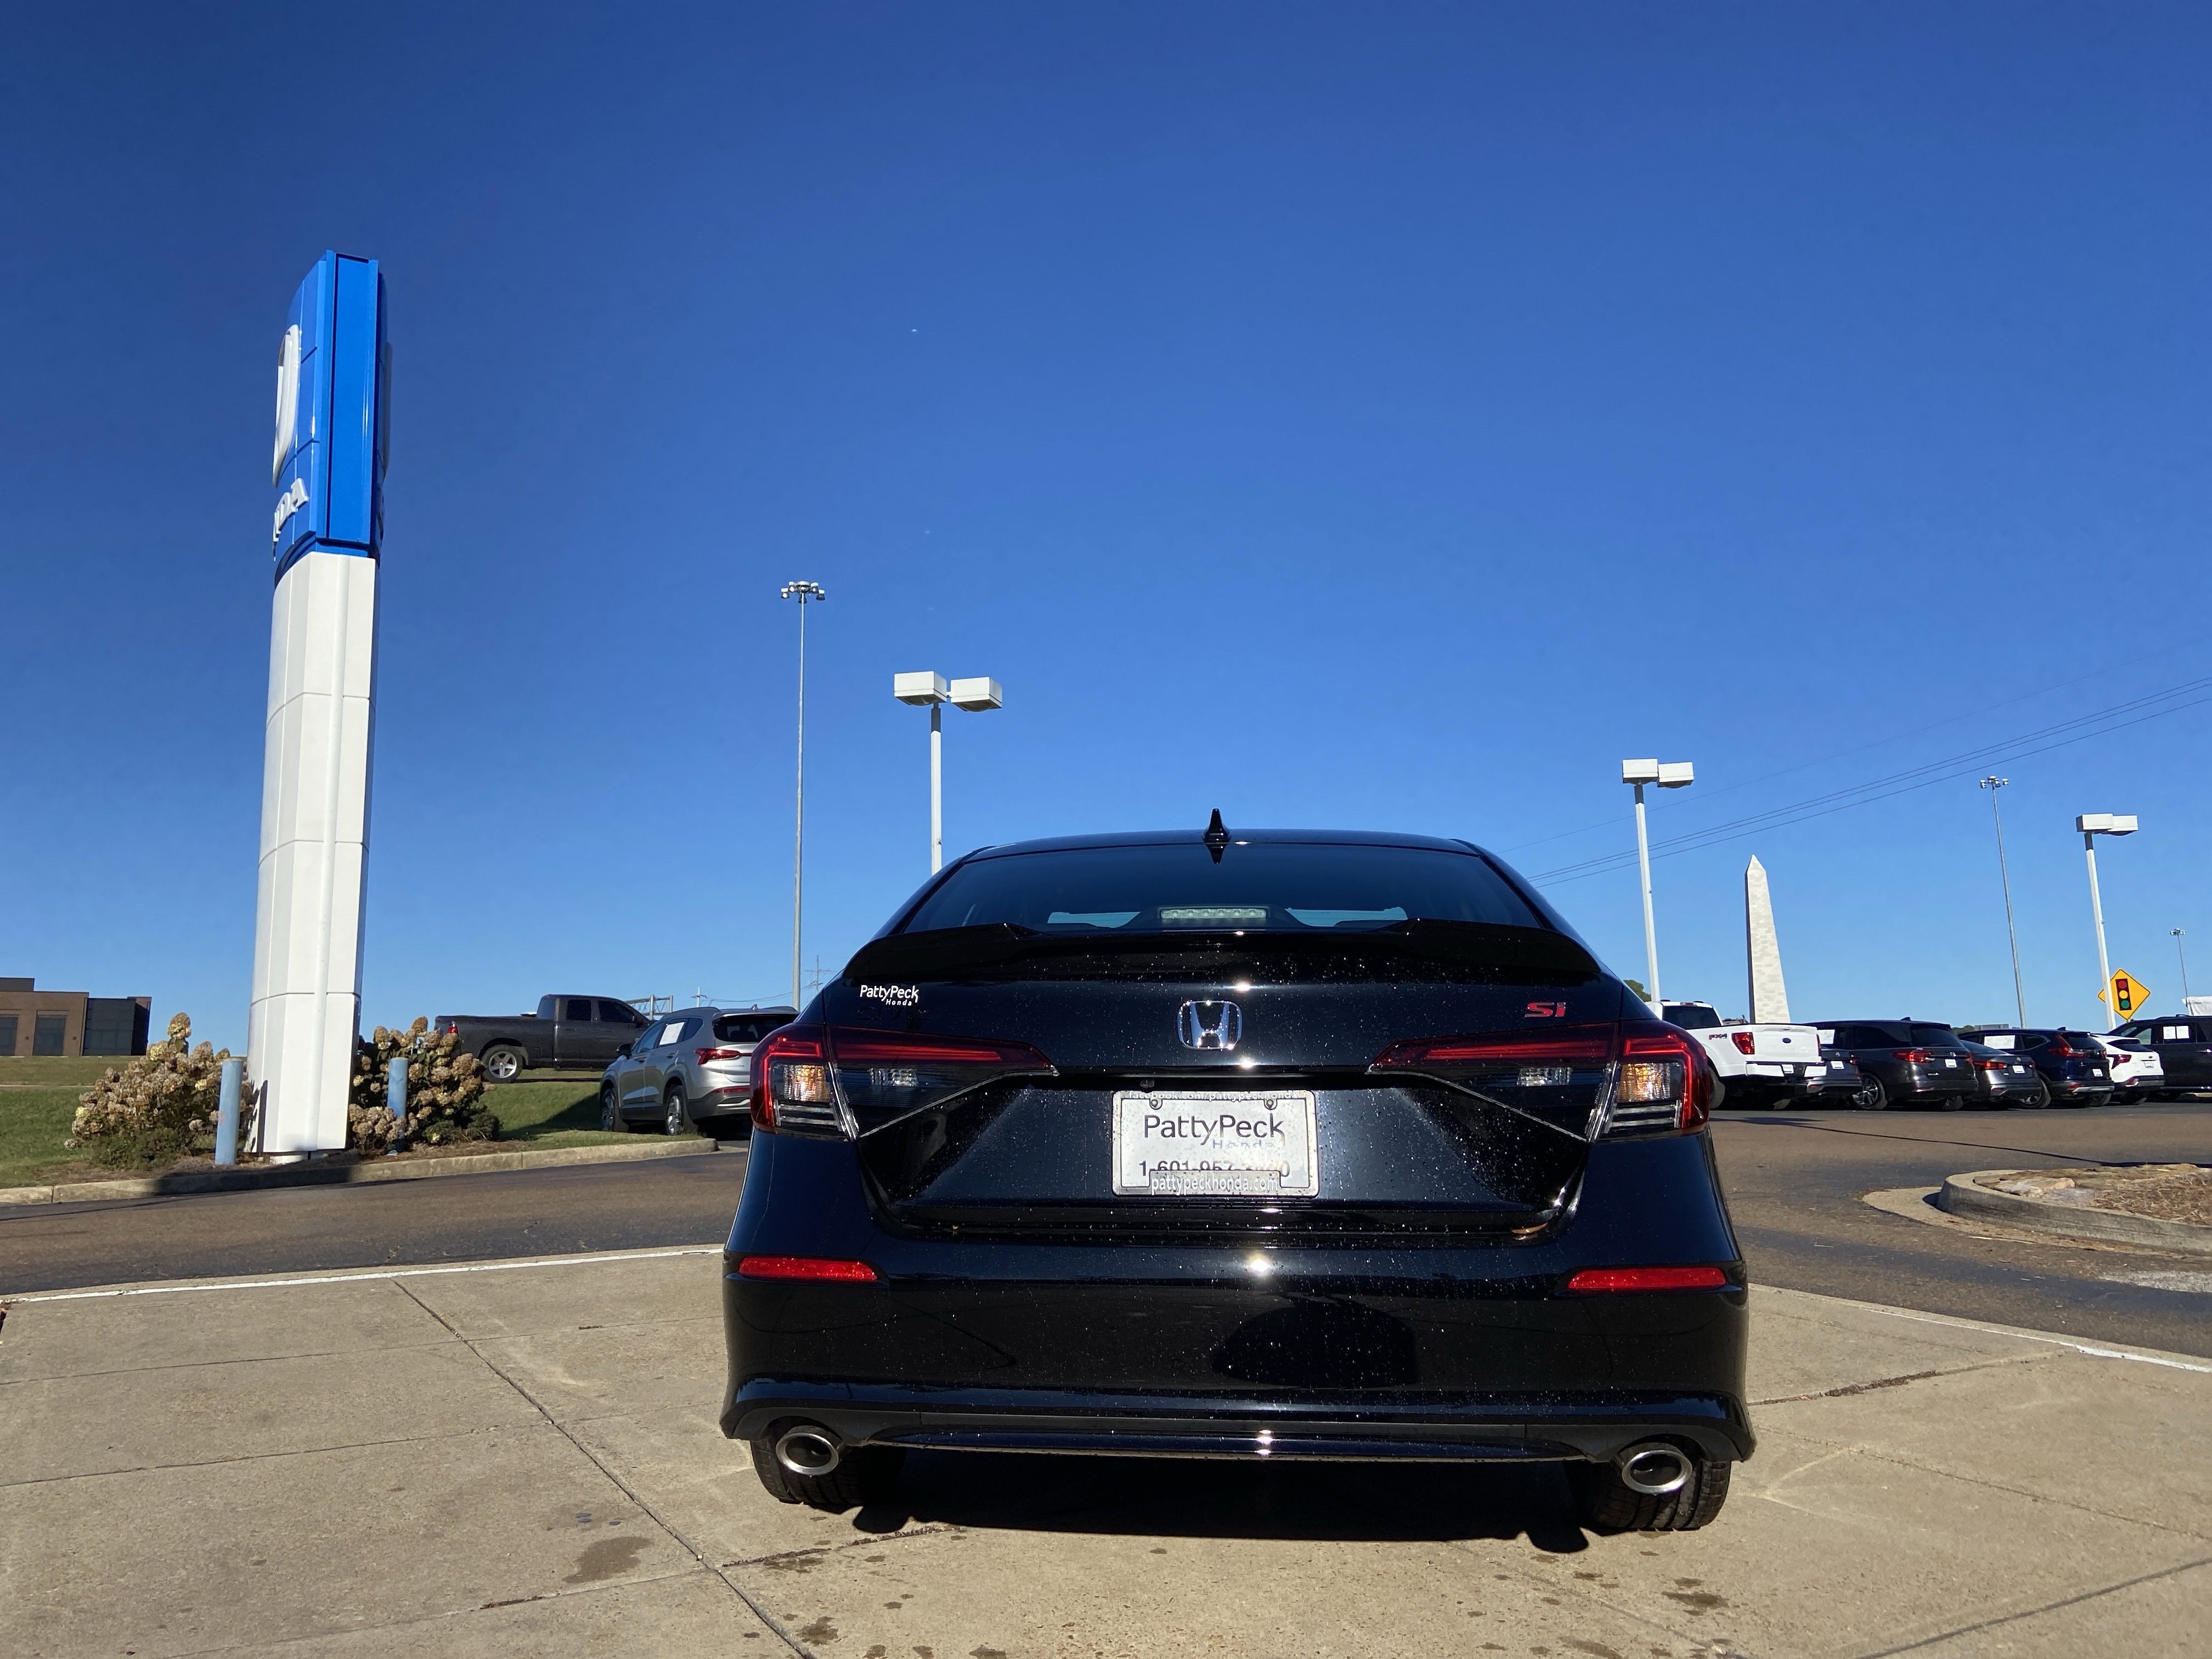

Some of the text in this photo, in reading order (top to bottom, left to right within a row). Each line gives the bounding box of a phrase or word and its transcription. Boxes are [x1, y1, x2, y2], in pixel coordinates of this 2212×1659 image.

[860, 985, 919, 1003] PattyPeck
[1525, 1002, 1566, 1017] Si
[1144, 1114, 1285, 1147] PattyPeck
[1213, 1139, 1274, 1149] Honda
[1152, 1173, 1278, 1196] pattypeckhonda.com
